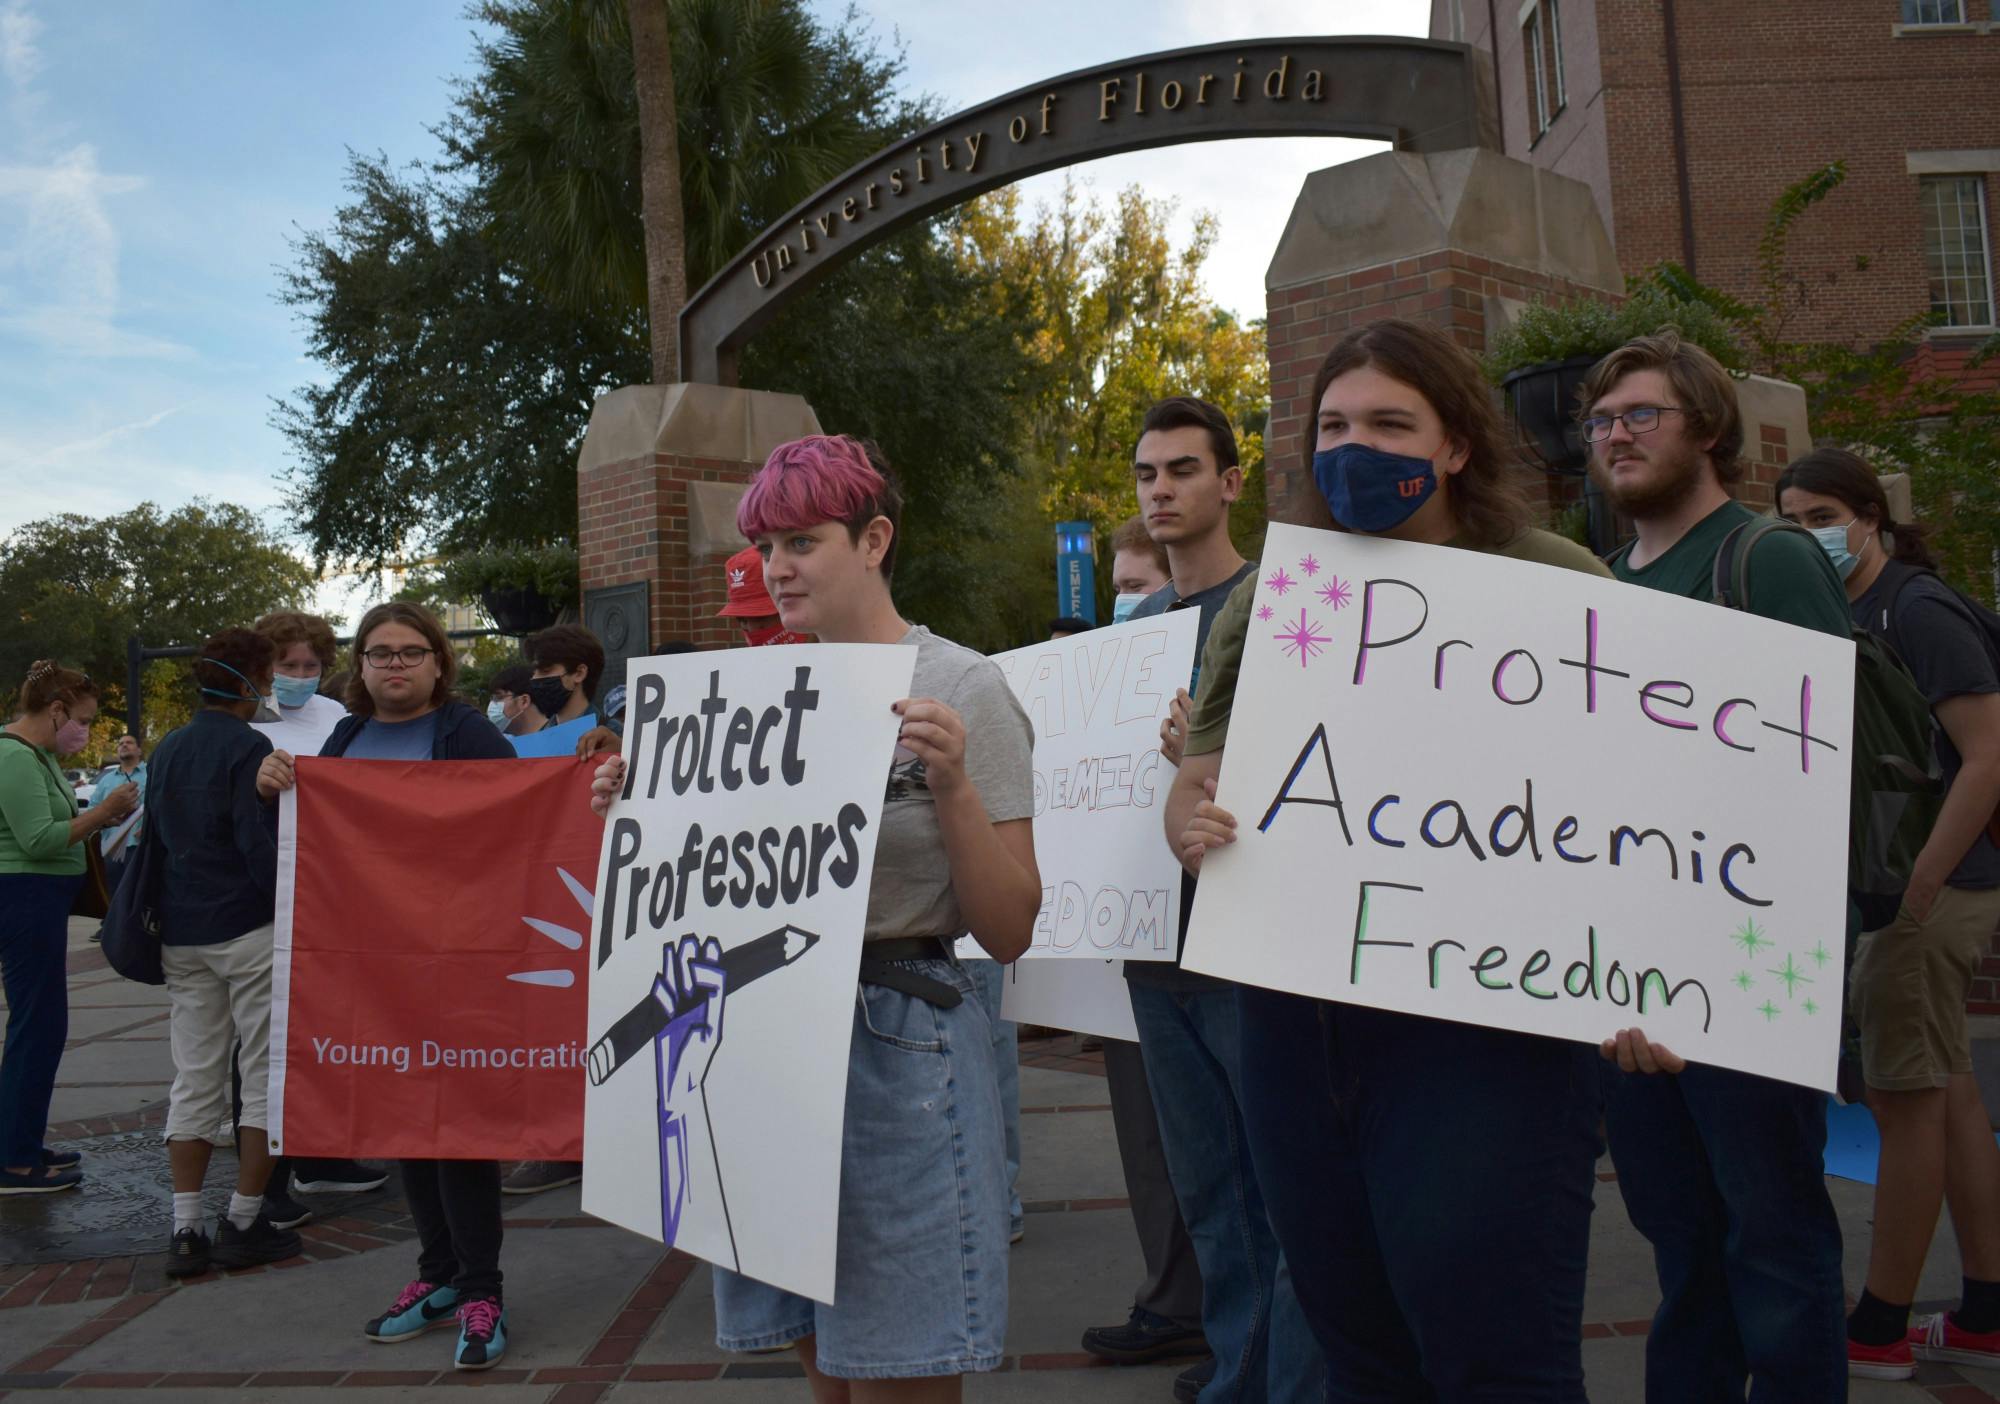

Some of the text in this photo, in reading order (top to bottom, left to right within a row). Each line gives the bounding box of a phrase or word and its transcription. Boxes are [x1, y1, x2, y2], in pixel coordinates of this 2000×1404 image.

[750, 55, 1328, 289] University of Florida
[1398, 477, 1425, 497] UF
[621, 666, 820, 800] Protect
[1353, 578, 1838, 775] Protect
[1032, 749, 1160, 818] DEMIC
[1258, 723, 1773, 906] Academic
[597, 802, 868, 971] Professors
[1030, 881, 1170, 952] EDOM
[1349, 881, 1711, 1034] Freedom
[312, 1037, 410, 1072] Young
